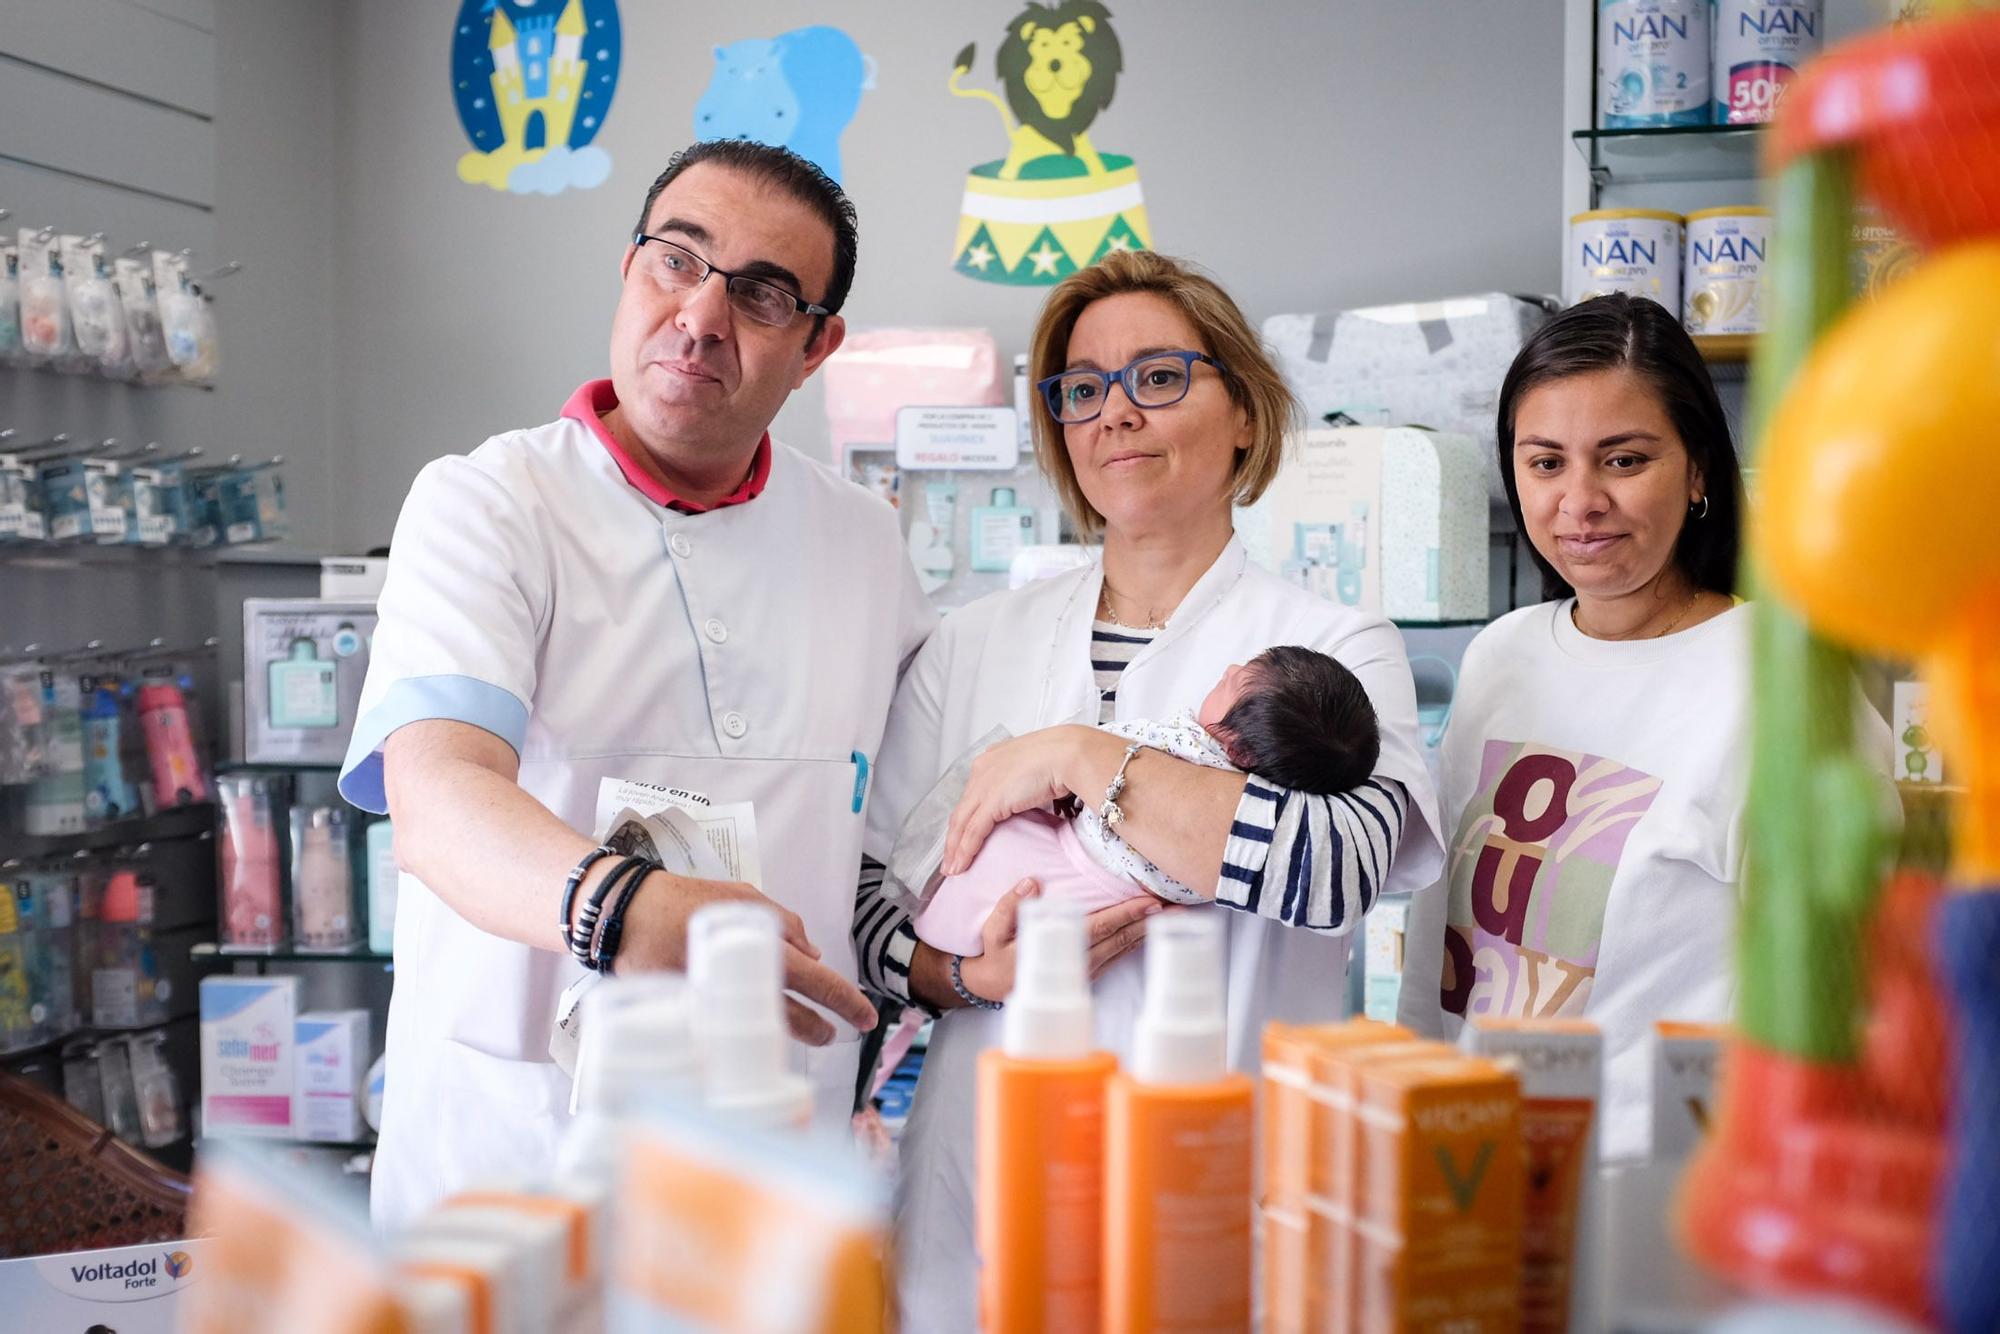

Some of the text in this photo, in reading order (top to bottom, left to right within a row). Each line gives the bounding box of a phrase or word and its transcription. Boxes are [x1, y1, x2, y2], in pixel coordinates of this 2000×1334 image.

[1614, 14, 1687, 46] NAN
[1739, 8, 1815, 37] NAN
[1676, 71, 1687, 89] 2
[1582, 239, 1656, 267] NAN
[1692, 236, 1766, 266] NAN
[669, 788, 690, 799] en
[71, 1258, 157, 1283] Voltadol
[124, 1278, 157, 1290] Forte
